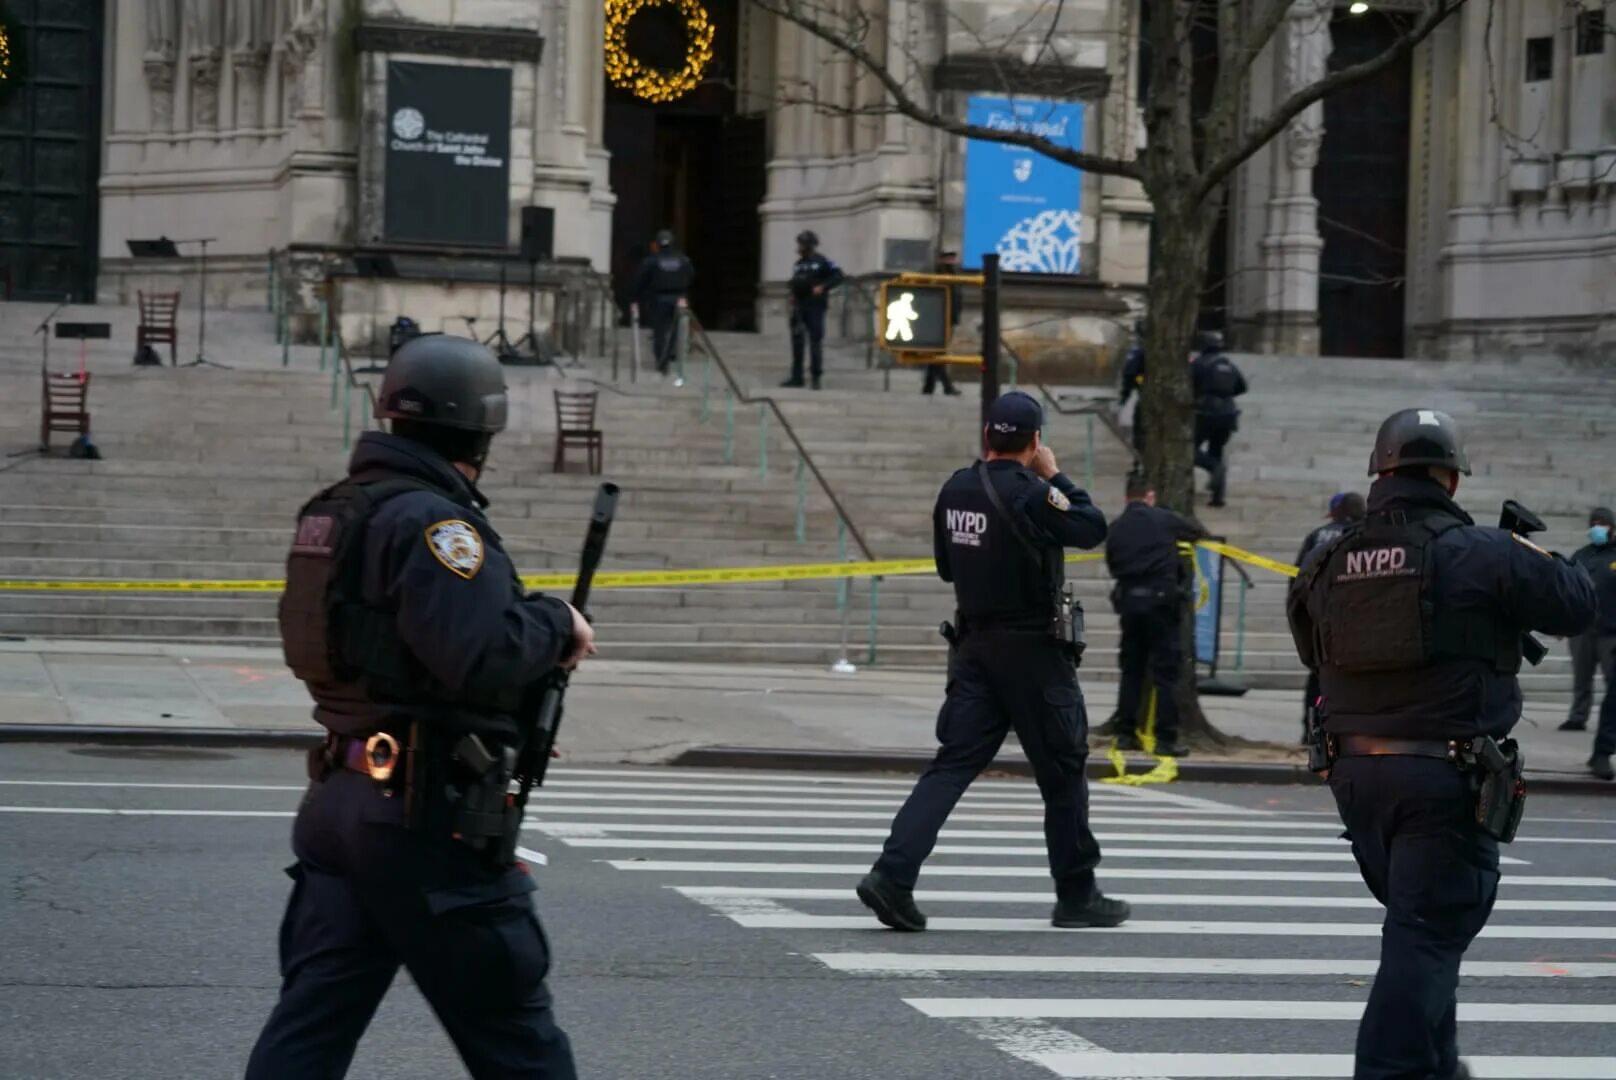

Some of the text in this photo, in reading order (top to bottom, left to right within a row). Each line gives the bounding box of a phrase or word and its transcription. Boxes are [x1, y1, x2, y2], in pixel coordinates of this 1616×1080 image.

[391, 139, 424, 152] Church
[946, 509, 987, 534] NYPD
[1346, 547, 1406, 574] NYPD
